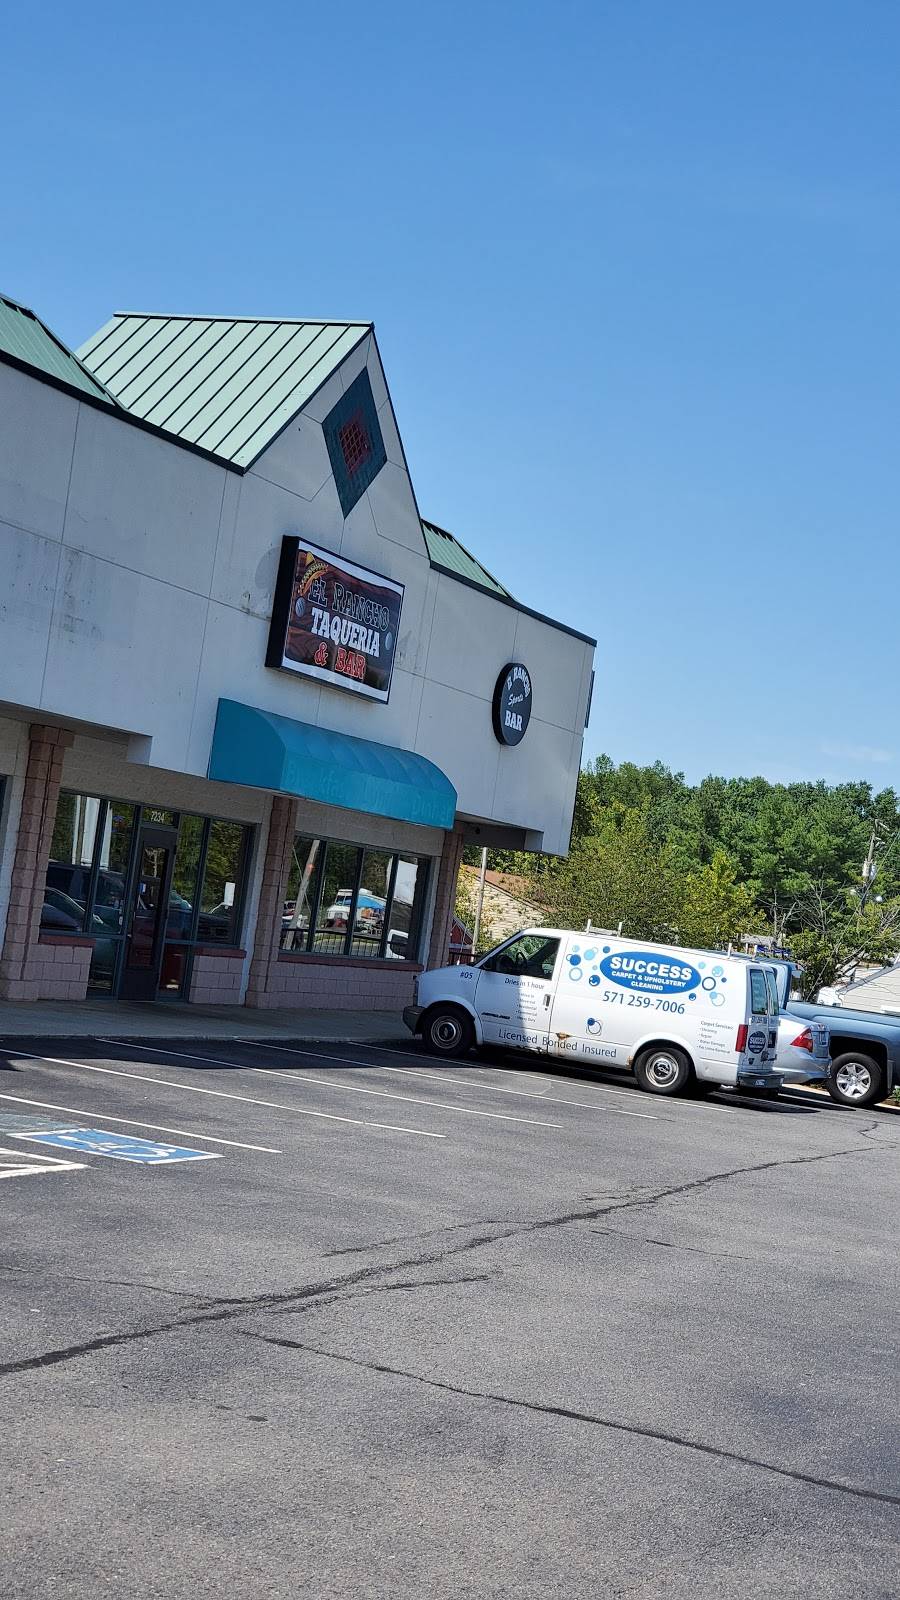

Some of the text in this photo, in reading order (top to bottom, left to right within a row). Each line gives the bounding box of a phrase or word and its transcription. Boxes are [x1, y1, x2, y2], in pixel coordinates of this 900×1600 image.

[307, 580, 390, 632] EL RANCHO
[310, 606, 381, 658] TAQUERIA
[314, 641, 366, 680] & BAR
[504, 709, 523, 732] BAR
[150, 810, 165, 823] 7234
[459, 971, 474, 980] #05
[609, 956, 693, 981] SUCCESS
[611, 970, 637, 980] CARPET
[644, 975, 687, 988] UPHOLSTERY
[504, 977, 520, 986] Dries
[531, 981, 545, 990] hour
[630, 980, 664, 991] CLEANING
[602, 990, 686, 1015] 571 259-7006
[498, 1028, 618, 1058] Licensed Bonded Insured
